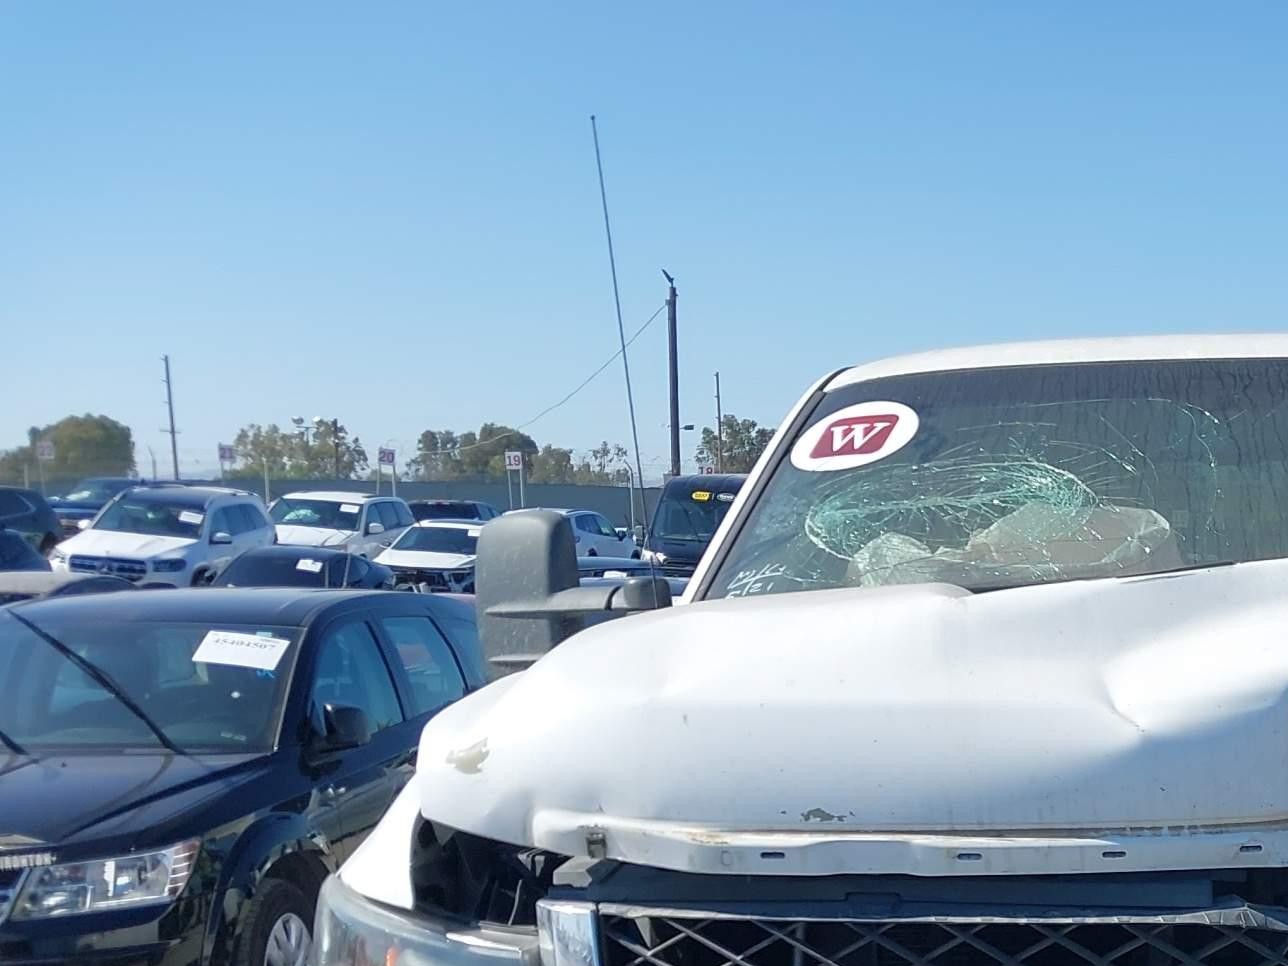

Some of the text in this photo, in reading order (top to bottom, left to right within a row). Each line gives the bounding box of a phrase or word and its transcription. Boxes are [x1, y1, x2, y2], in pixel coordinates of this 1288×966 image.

[830, 421, 892, 452] W
[380, 451, 395, 463] 20
[506, 455, 521, 466] 19
